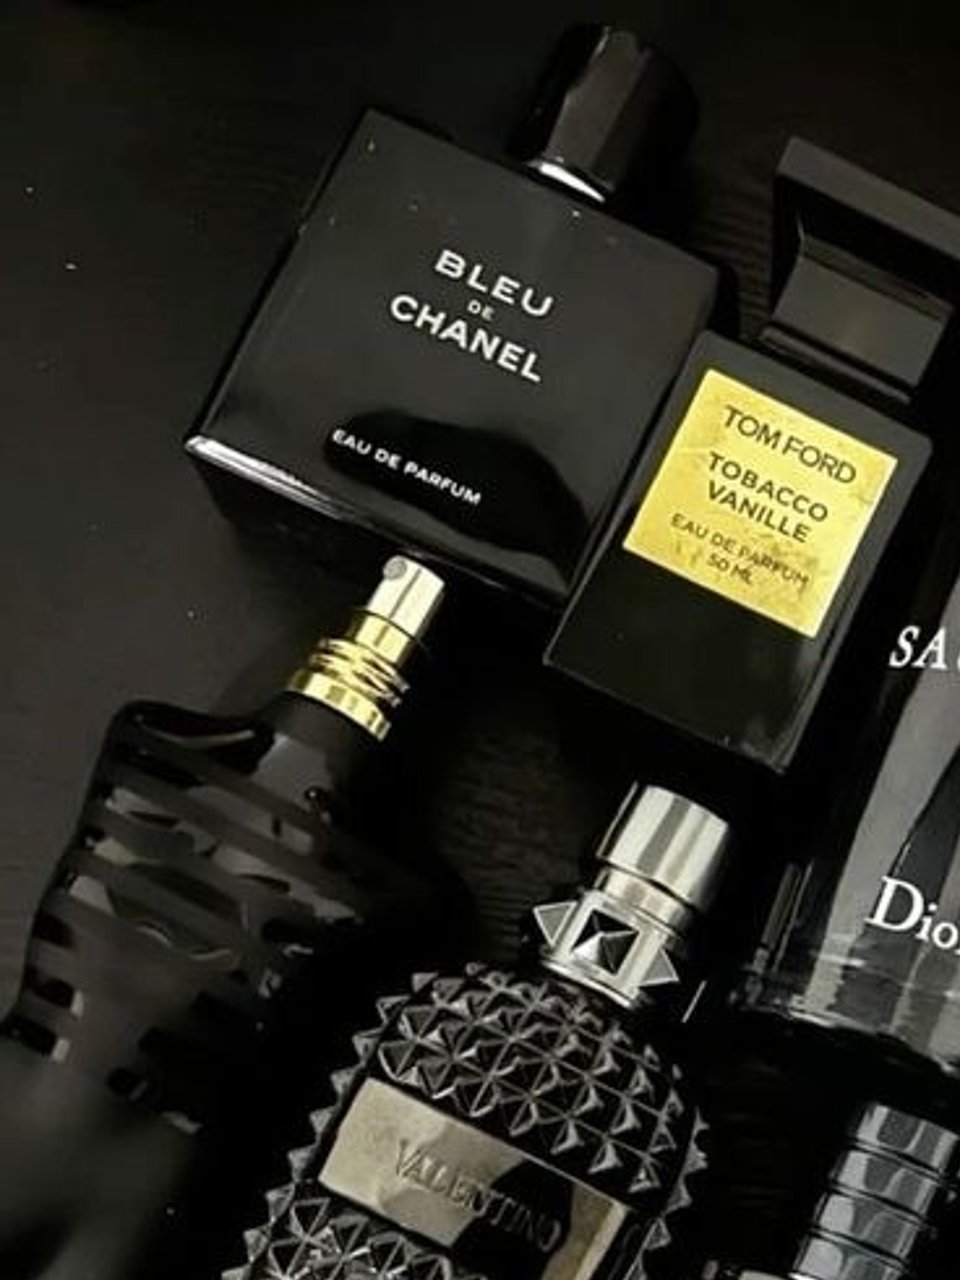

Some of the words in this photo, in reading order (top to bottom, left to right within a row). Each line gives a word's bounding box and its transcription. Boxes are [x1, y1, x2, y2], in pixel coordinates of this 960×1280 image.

[435, 249, 554, 316] BLEU
[466, 299, 495, 321] DE
[391, 295, 541, 383] CHANEL
[332, 429, 371, 455] EAU
[374, 448, 401, 470] DE
[404, 461, 481, 505] PARFUM
[724, 404, 782, 450] TOM
[782, 435, 856, 484] FORD
[708, 451, 828, 522] TOBACCO
[708, 479, 812, 544] VANILLE
[671, 512, 710, 539] EAU
[711, 532, 737, 552] DE
[738, 545, 810, 586] PARFUM
[706, 554, 730, 573] 50
